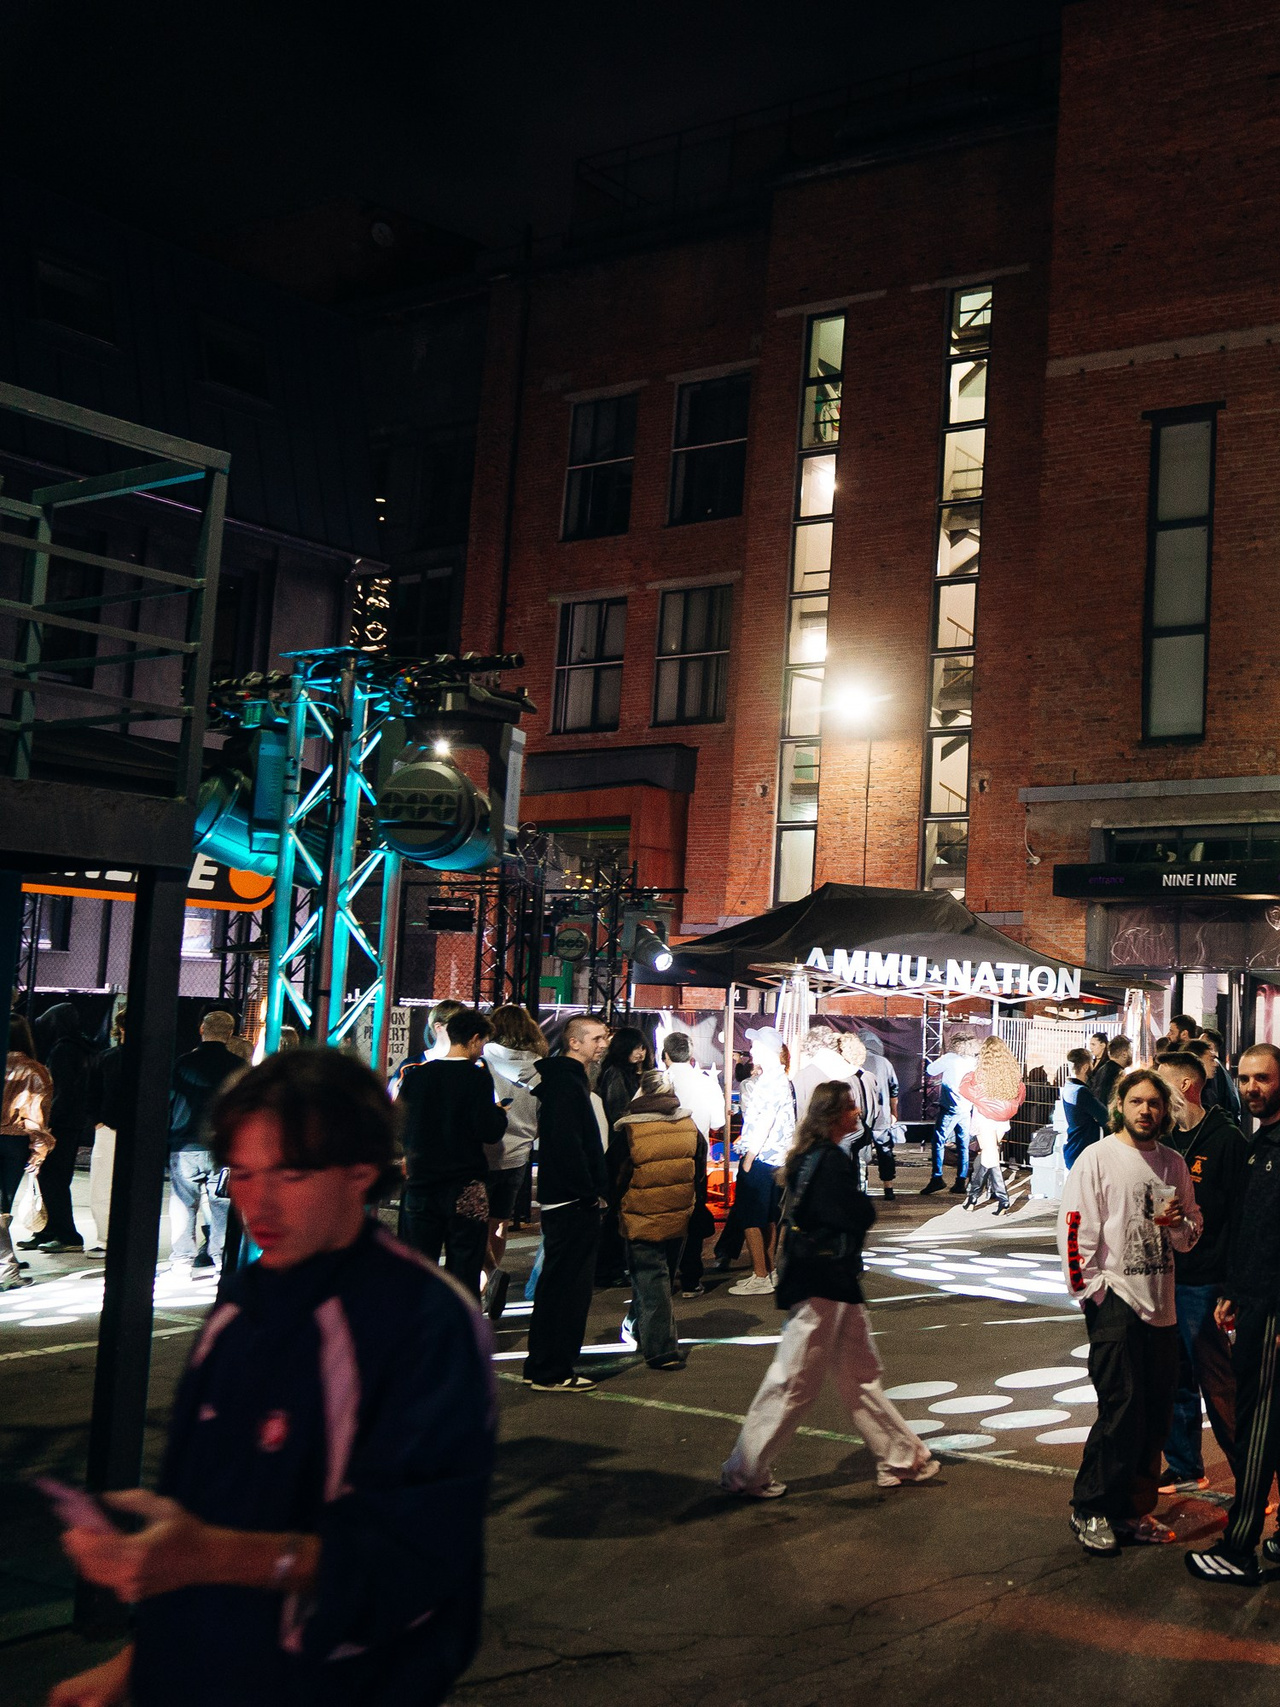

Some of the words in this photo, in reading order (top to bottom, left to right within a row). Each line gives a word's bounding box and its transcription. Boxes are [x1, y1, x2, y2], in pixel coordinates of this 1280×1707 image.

[1088, 875, 1125, 885] entrance
[1162, 873, 1194, 887] NINE
[1203, 873, 1238, 886] NINE
